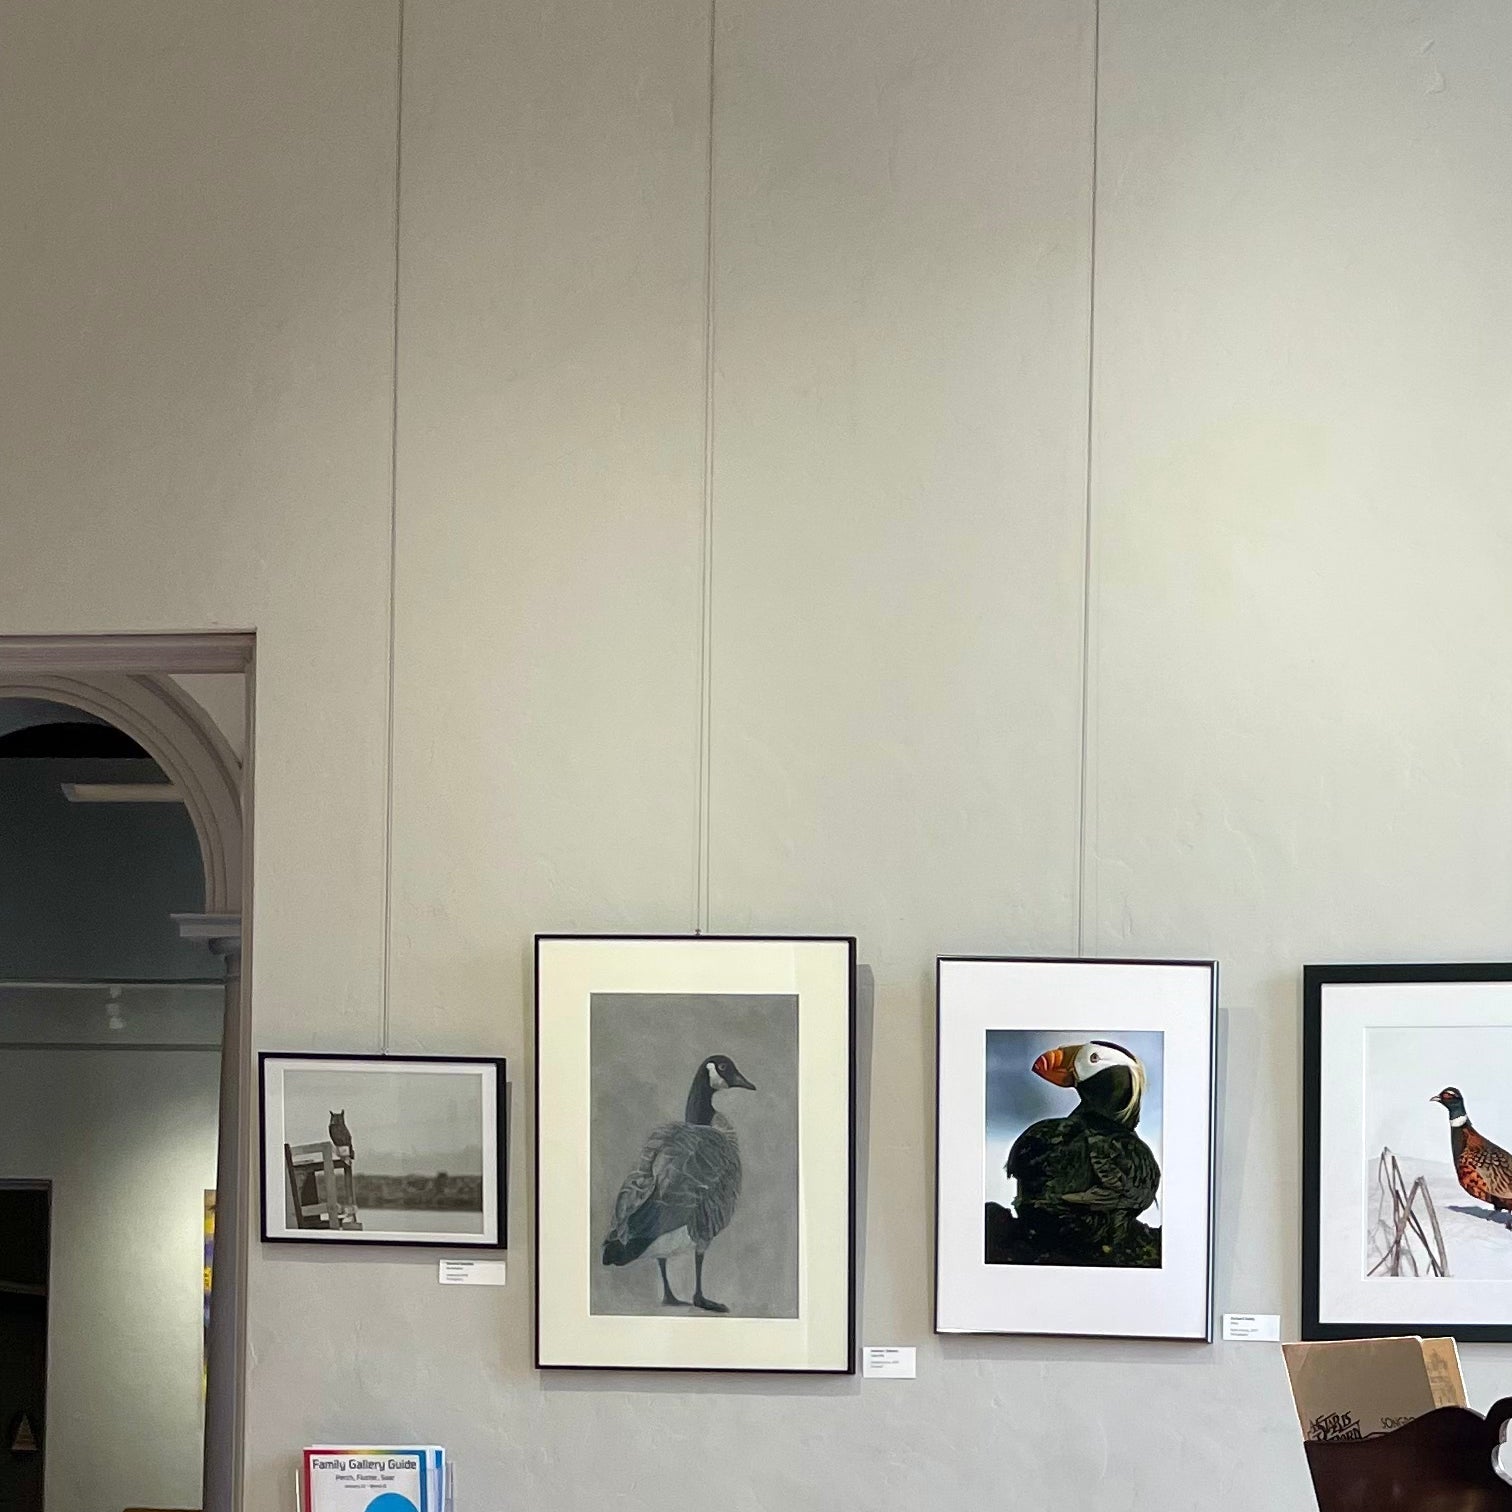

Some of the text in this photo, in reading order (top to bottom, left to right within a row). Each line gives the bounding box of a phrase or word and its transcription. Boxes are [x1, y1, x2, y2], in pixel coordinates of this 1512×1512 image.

[313, 1459, 417, 1471] Family Gallery Guide
